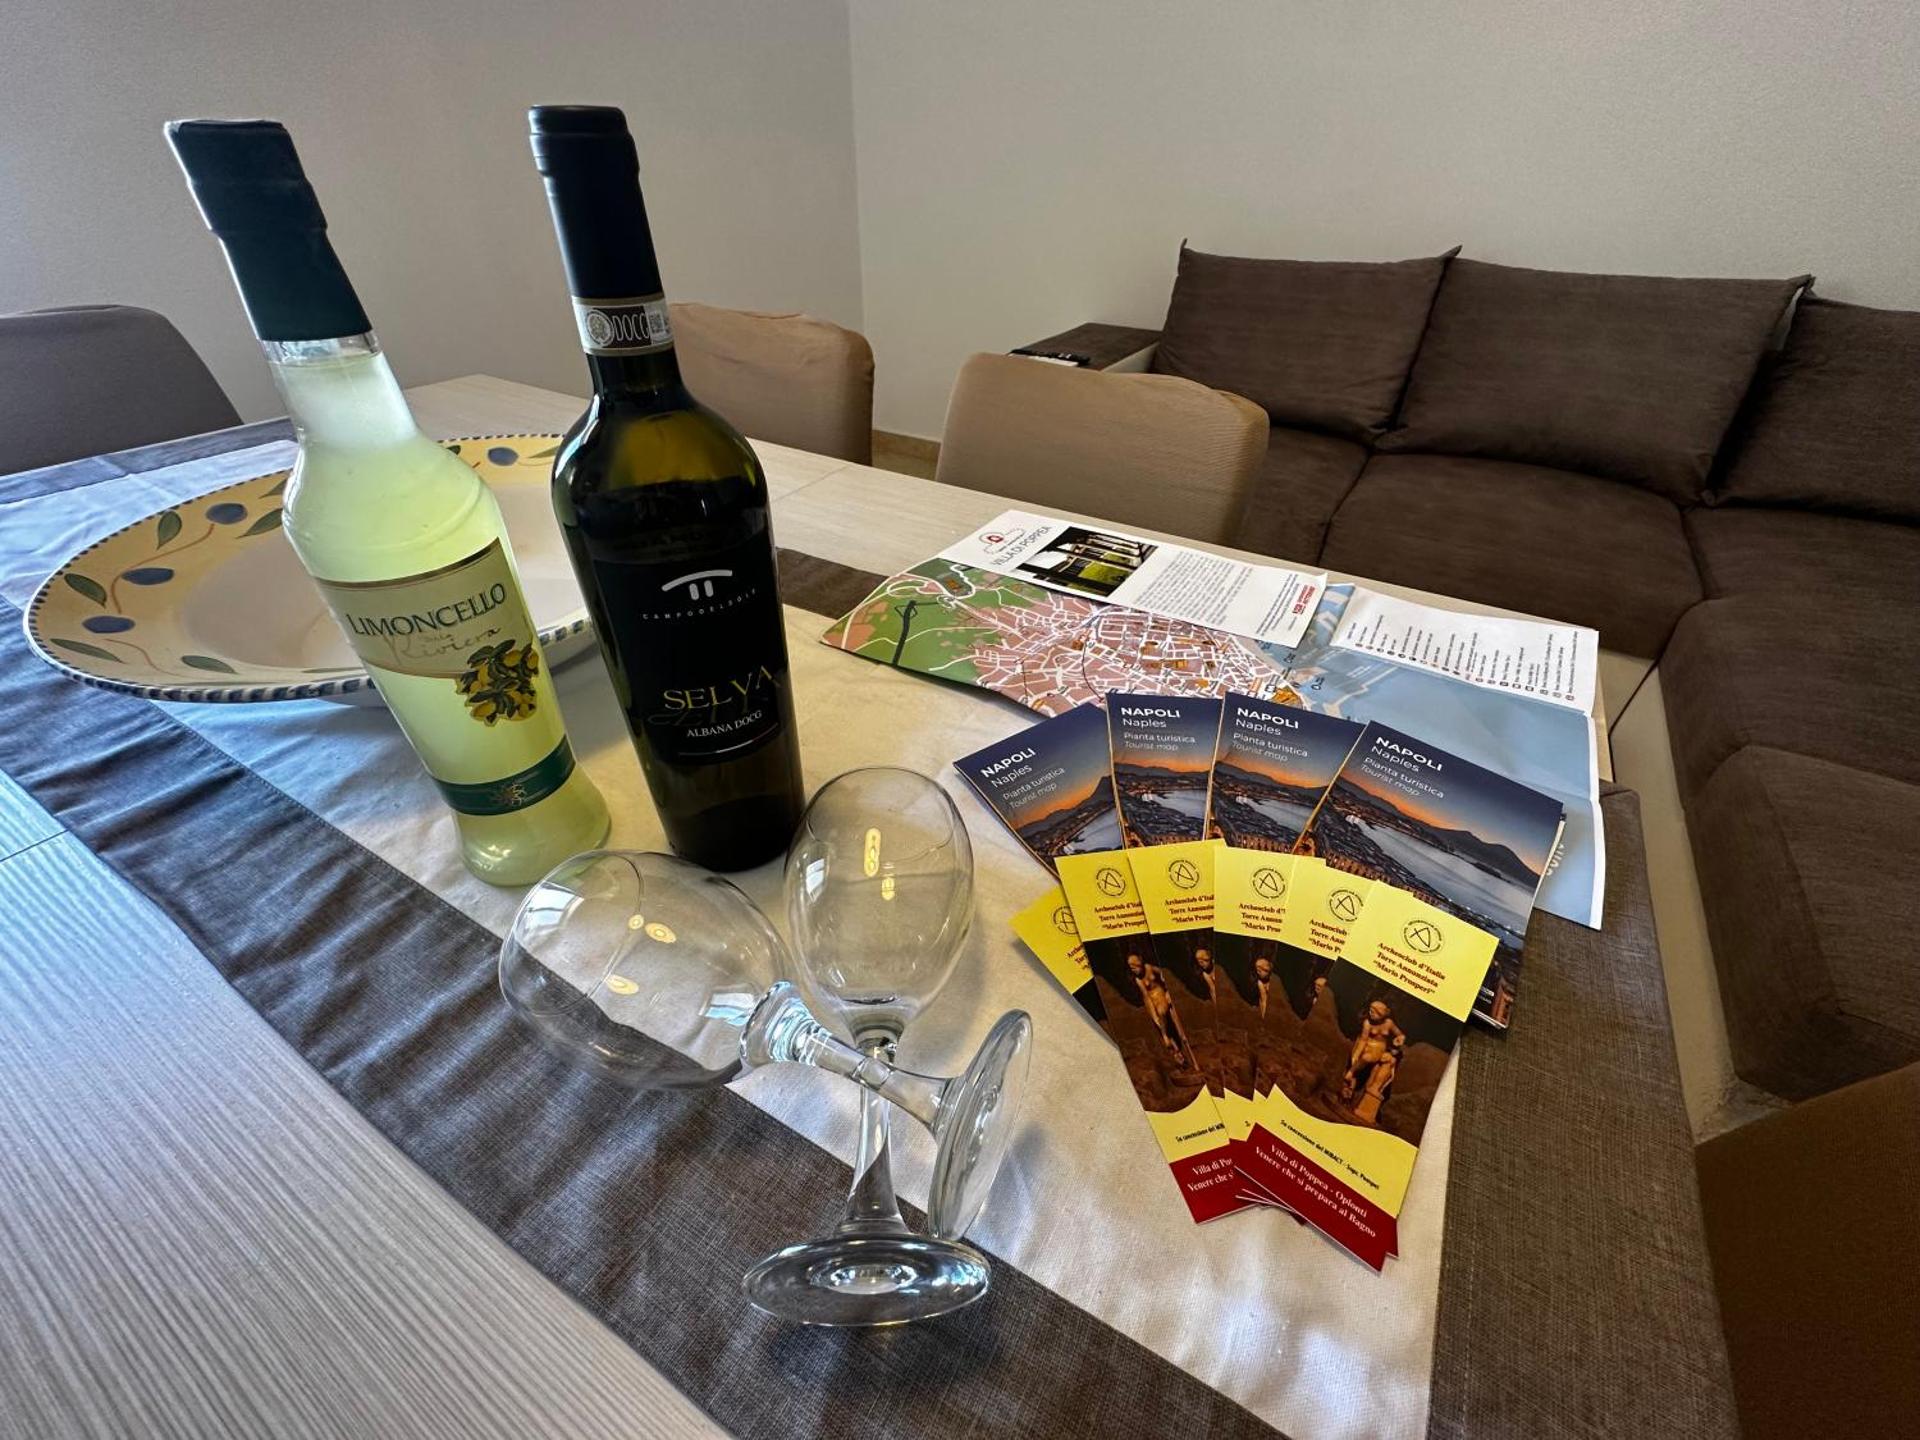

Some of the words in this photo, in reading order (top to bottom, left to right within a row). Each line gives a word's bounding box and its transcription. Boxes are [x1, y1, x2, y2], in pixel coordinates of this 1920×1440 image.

[345, 582, 507, 637] LIMONCELLO
[663, 664, 781, 710] SELVA
[686, 722, 734, 738] ALBANA
[735, 709, 763, 729] DOCG
[1120, 706, 1181, 719] NAPOLI
[1122, 718, 1167, 729] Naples
[1237, 706, 1299, 729] NAPOLI
[1123, 731, 1154, 741] Pianta
[1156, 733, 1196, 743] turistica
[1235, 718, 1281, 736] Naples
[1125, 740, 1154, 750] Tourist
[1156, 743, 1178, 752] map
[1232, 740, 1263, 755] Tourist
[1264, 750, 1288, 762] map
[1233, 732, 1266, 747] Pianta
[1267, 741, 1308, 758] turistica
[1375, 736, 1443, 772] NAPOLI
[980, 747, 1036, 778] NAPOLI
[1371, 745, 1420, 772] Naples
[991, 764, 1033, 788] Naples
[1003, 783, 1032, 801] Pianta
[1031, 767, 1066, 787] turistica
[1361, 763, 1393, 784] Tourist
[1394, 781, 1420, 796] map
[1363, 756, 1399, 777] Pianta
[1400, 773, 1445, 799] turistica
[1009, 791, 1038, 809] Tourist
[1037, 782, 1057, 797] map
[1239, 903, 1275, 914] Archeoclub
[1241, 912, 1259, 920] Torre
[1309, 919, 1347, 936] Archeoclub
[1311, 927, 1329, 940] Torre
[1373, 959, 1399, 978] "Mario
[1377, 942, 1418, 966] Archeoclub
[1418, 962, 1446, 980] d'Italia
[1377, 951, 1397, 966] Torre
[1396, 962, 1438, 988] Annunziata
[1192, 1163, 1212, 1176] Villa
[1211, 1159, 1220, 1170] di
[1187, 1178, 1214, 1192] Venere
[1214, 1173, 1228, 1184] che
[1256, 1146, 1281, 1170] Venere
[1281, 1166, 1296, 1180] che
[1297, 1176, 1304, 1186] si
[1304, 1182, 1338, 1211] prepara
[1338, 1205, 1348, 1217] al
[1349, 1213, 1376, 1238] Bagno
[1271, 1144, 1289, 1162] Villa
[1289, 1159, 1298, 1169] di
[1299, 1165, 1329, 1190] Poppea
[1335, 1190, 1368, 1218] Oplonti
